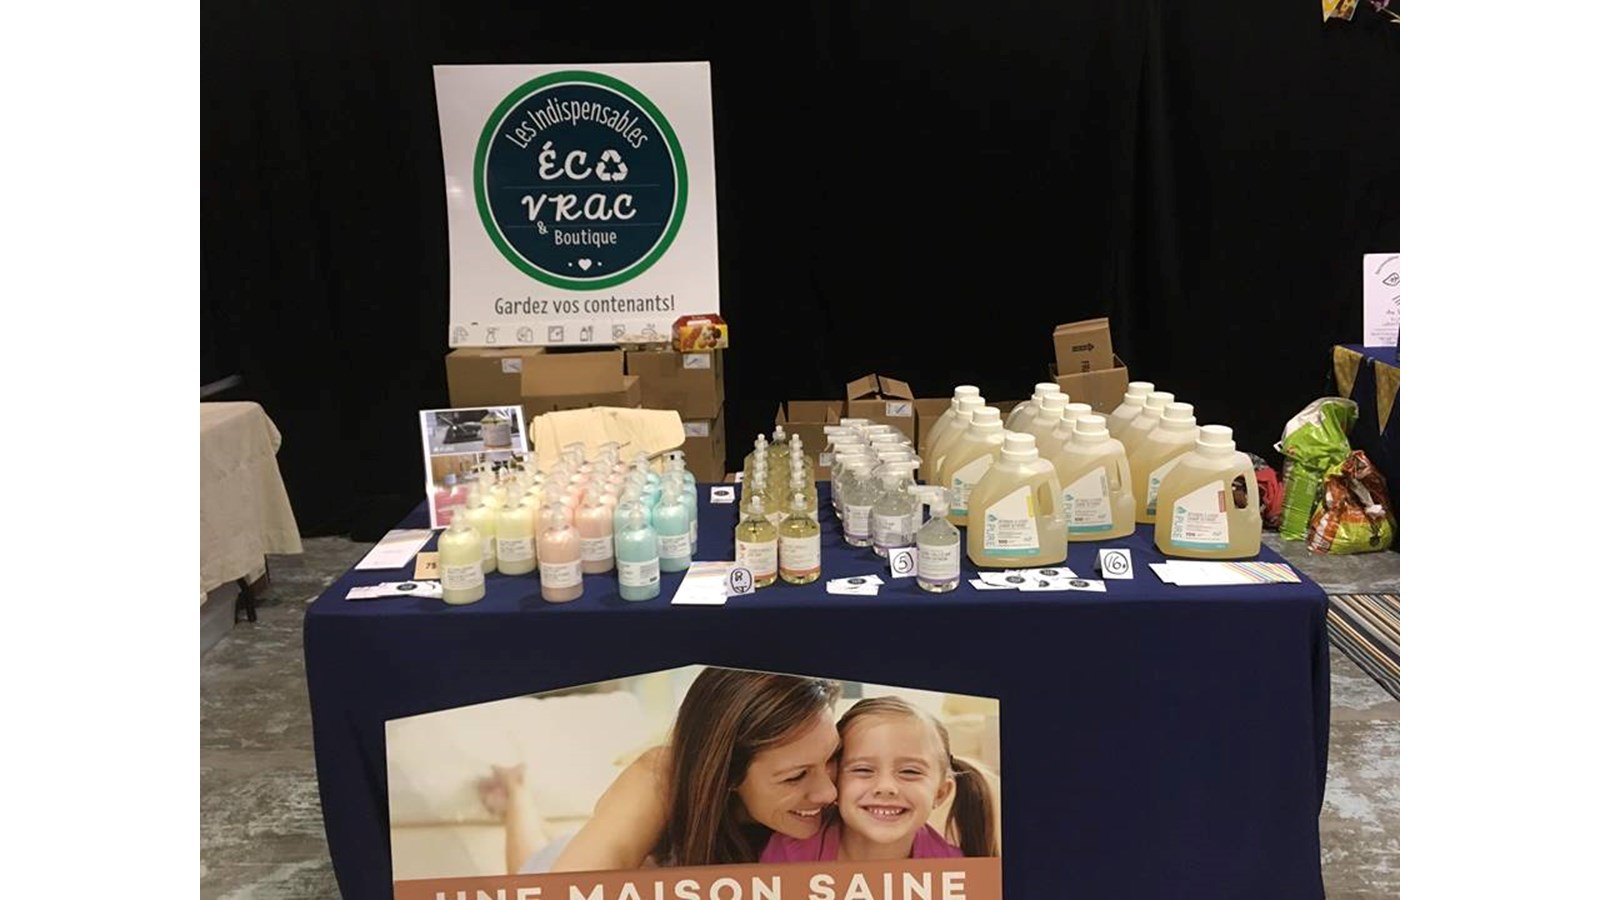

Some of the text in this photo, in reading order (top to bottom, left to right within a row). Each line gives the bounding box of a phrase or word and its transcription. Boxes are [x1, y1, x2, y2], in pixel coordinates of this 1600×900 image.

[505, 97, 649, 150] Les Indispensables
[536, 220, 549, 235] &
[554, 229, 618, 248] Boutique
[494, 295, 676, 315] Gardez vos contenants!
[808, 871, 967, 900] SAINE
